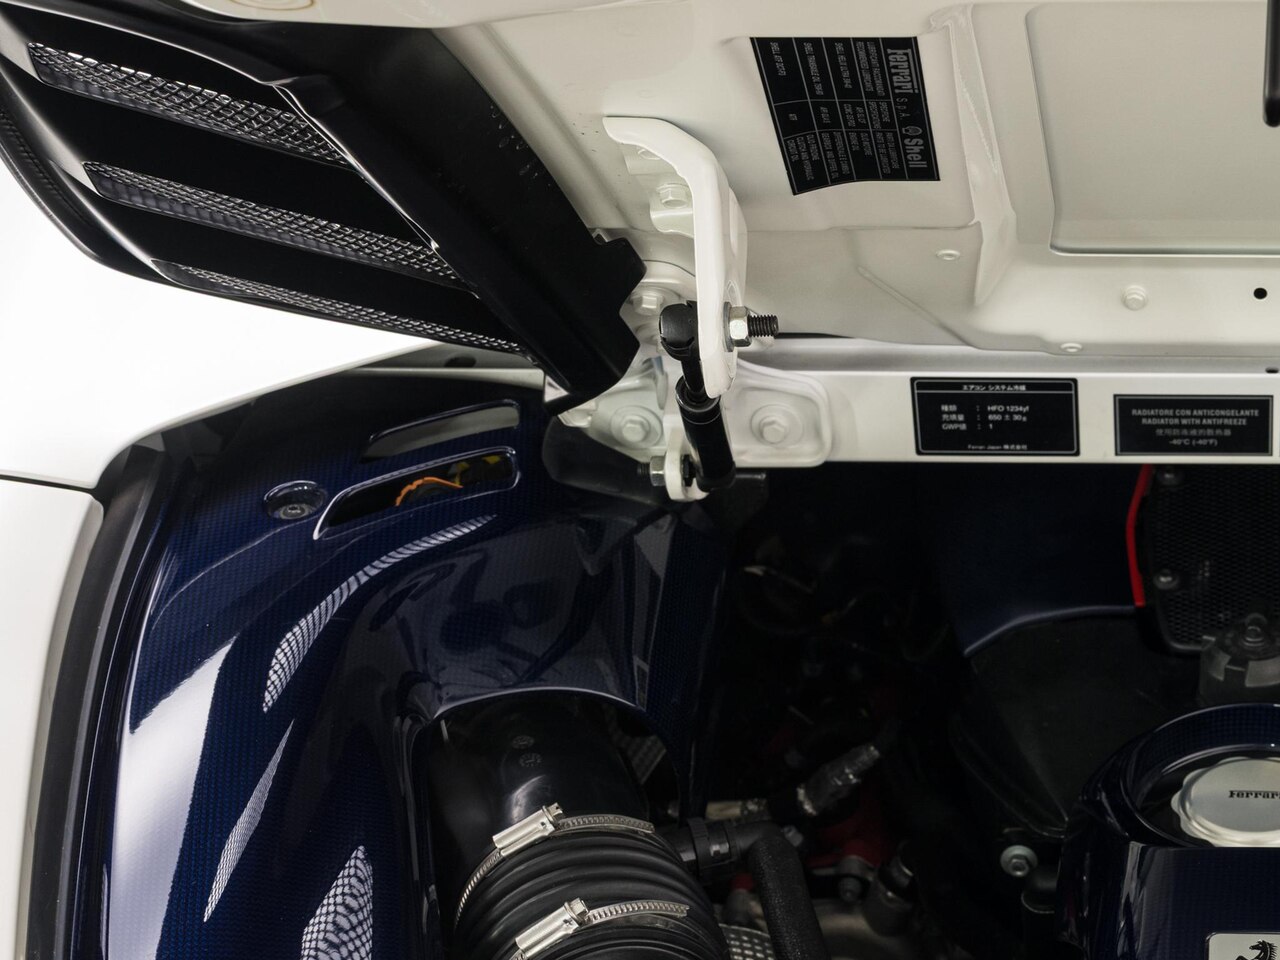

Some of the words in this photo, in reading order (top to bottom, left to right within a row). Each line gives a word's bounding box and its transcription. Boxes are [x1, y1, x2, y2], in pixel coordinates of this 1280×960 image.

[887, 48, 919, 94] Ferrari
[896, 97, 912, 120] S.p.A.
[904, 138, 928, 168] Shell
[1192, 409, 1259, 417] ANTICONGELANTE
